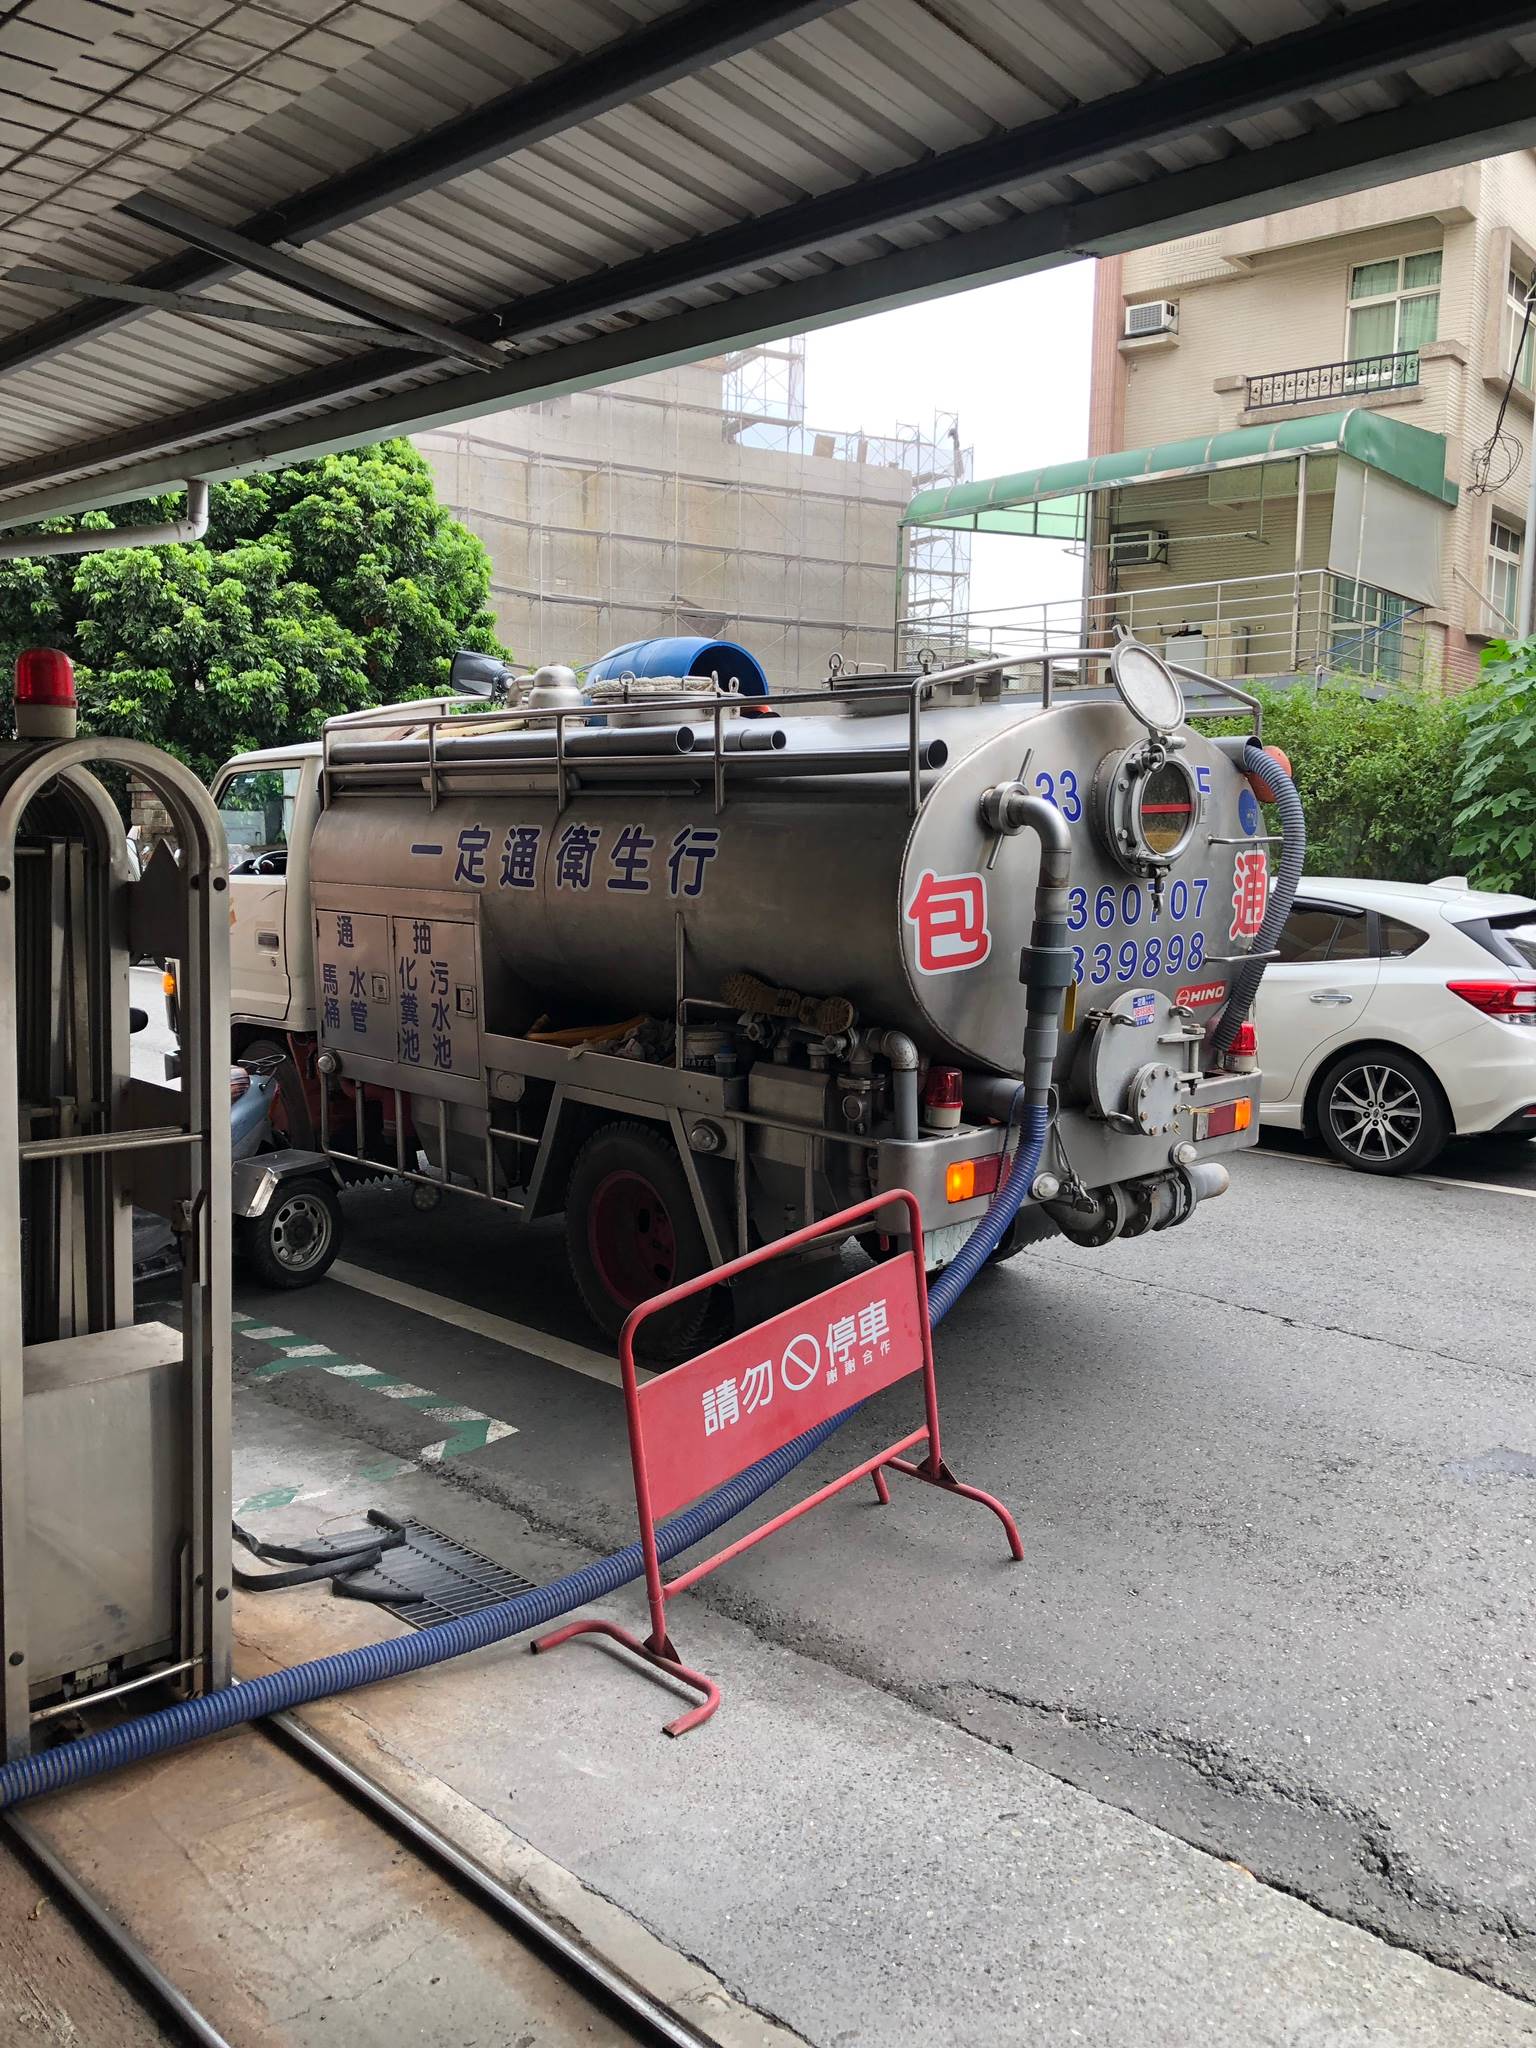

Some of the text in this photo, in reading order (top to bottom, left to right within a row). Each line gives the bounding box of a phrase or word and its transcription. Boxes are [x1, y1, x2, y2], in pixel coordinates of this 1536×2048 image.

[410, 823, 721, 898] 一定通衛生行
[1229, 849, 1268, 942] 通
[336, 914, 355, 948] 通
[412, 920, 432, 955] 抽
[905, 868, 993, 976] 包
[322, 963, 341, 1030] 馬桶
[348, 965, 368, 1034] 水管
[398, 956, 420, 1063] 化糞池
[430, 959, 452, 1070] 污水池
[1190, 986, 1225, 1001] HINO
[701, 1298, 890, 1437] 請勿 停車
[826, 1338, 891, 1387] 謝謝合作
